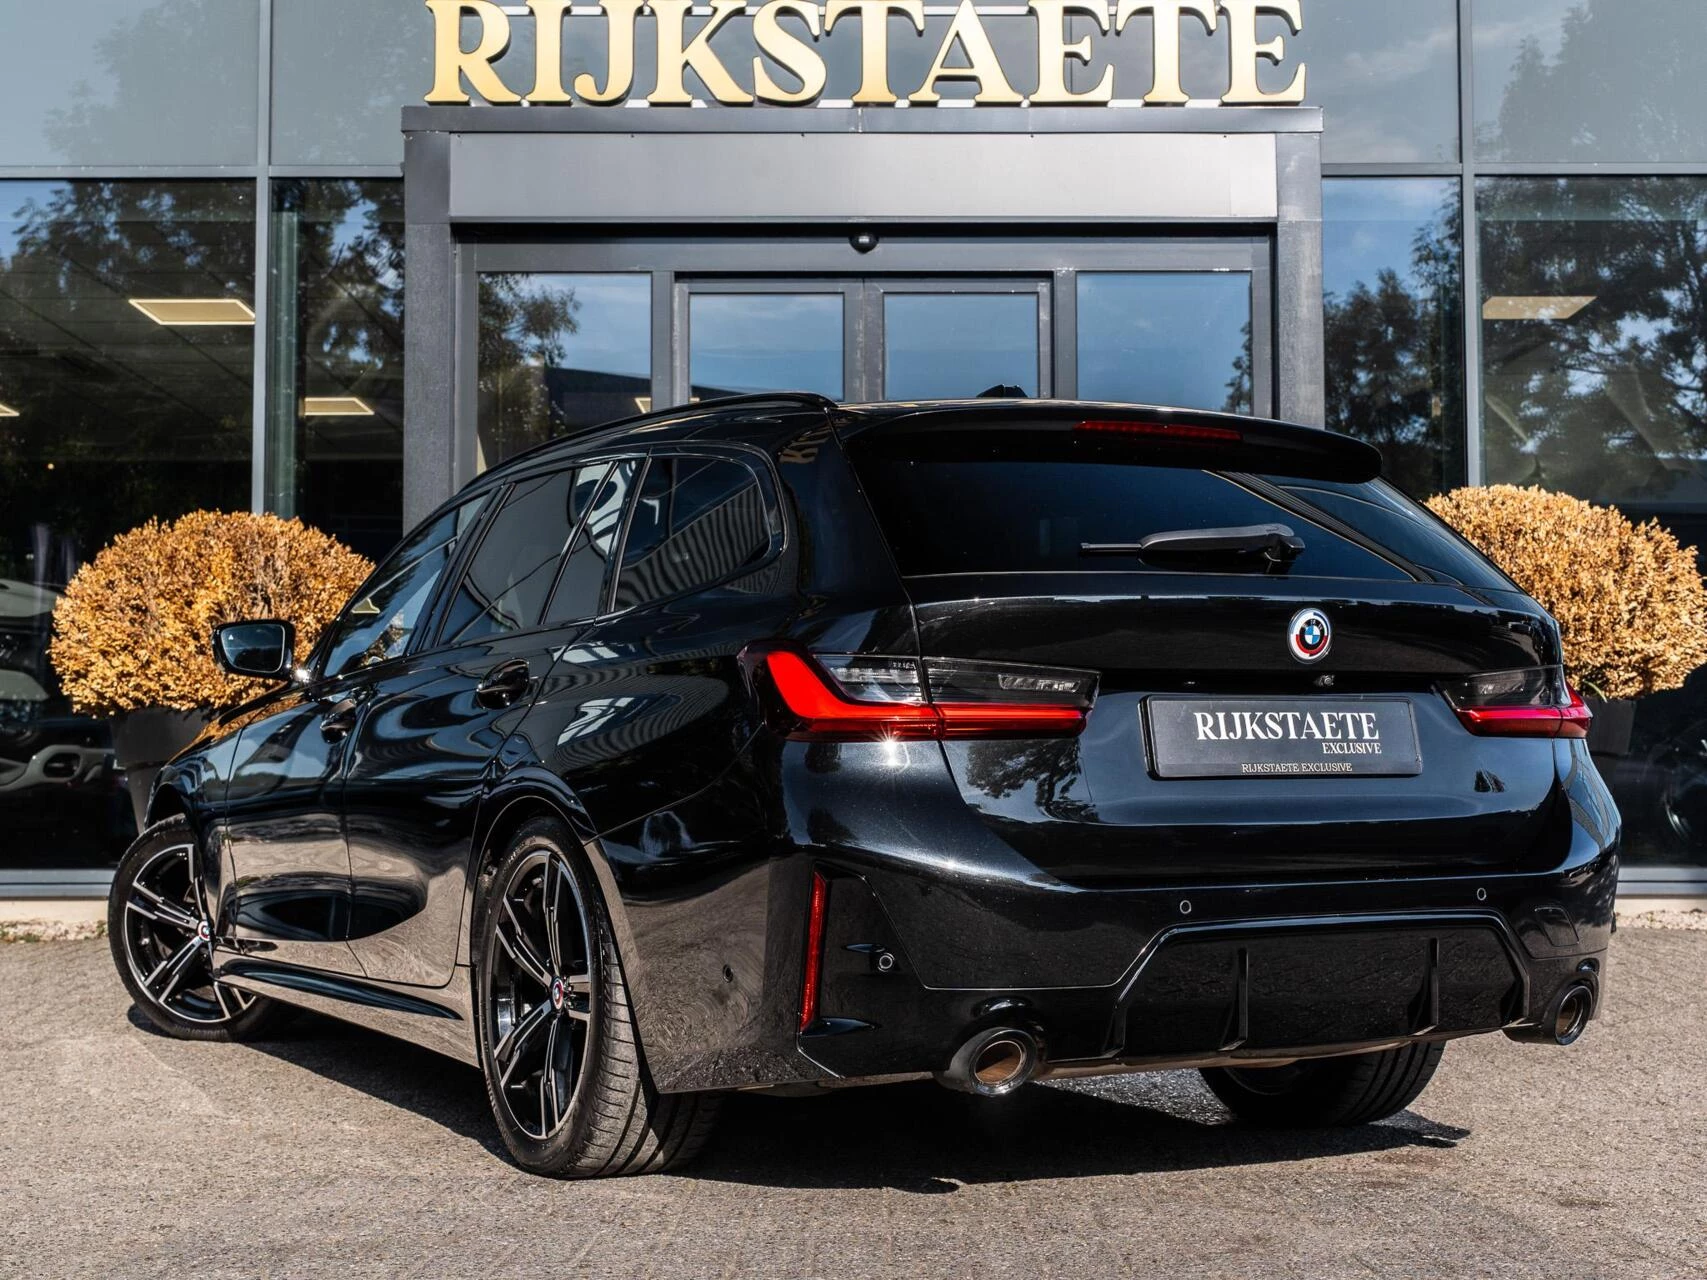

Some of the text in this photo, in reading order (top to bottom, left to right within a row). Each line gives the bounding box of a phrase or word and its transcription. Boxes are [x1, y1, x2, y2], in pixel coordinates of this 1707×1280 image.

[424, 0, 1306, 105] RIJKSTAETE
[1194, 711, 1380, 740] RIJKSTAETE
[1322, 742, 1382, 754] EXCLUSIVE
[1241, 762, 1353, 773] RIJKSTAETE EXCLUSIVE
